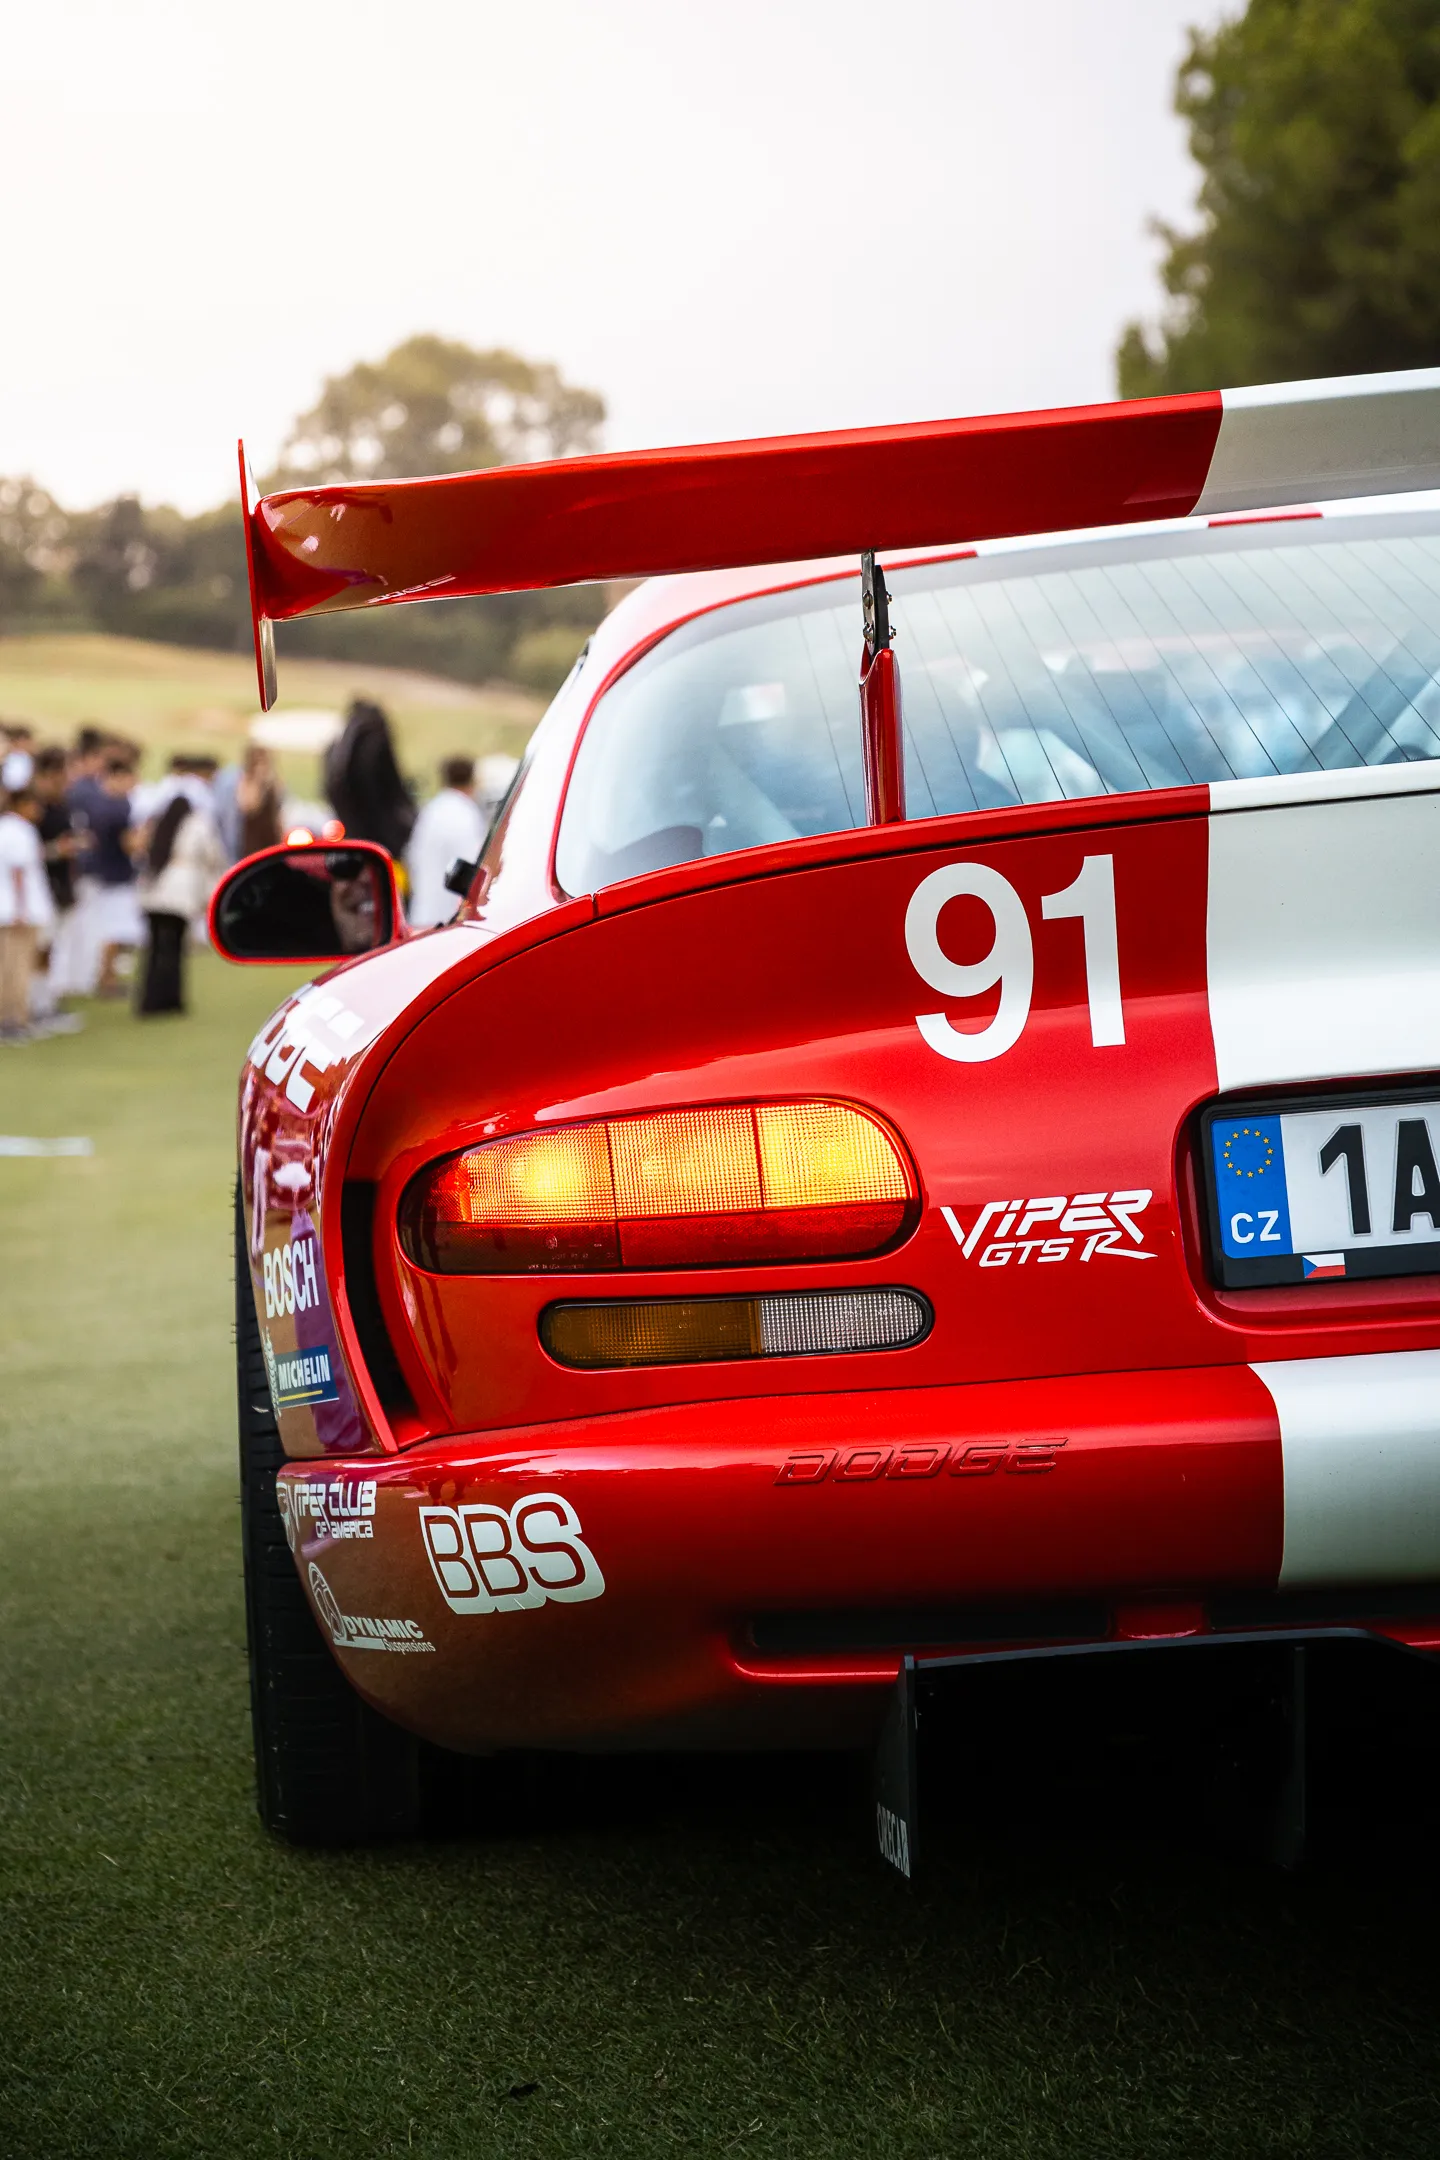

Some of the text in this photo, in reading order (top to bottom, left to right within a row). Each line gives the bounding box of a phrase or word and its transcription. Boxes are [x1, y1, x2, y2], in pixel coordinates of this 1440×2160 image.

[905, 854, 1126, 1062] 91
[1319, 1119, 1440, 1235] 1A
[1230, 1210, 1281, 1243] CZ
[979, 1230, 1158, 1267] GTS R
[263, 1238, 320, 1318] BOSCH
[277, 1354, 331, 1391] MICHELIN
[773, 1437, 1068, 1485] DODGE
[328, 1481, 377, 1517] CLUB
[315, 1521, 327, 1538] OF
[420, 1495, 602, 1610] BBS
[341, 1615, 424, 1639] DYNAMIC
[382, 1638, 436, 1655] Suspensions
